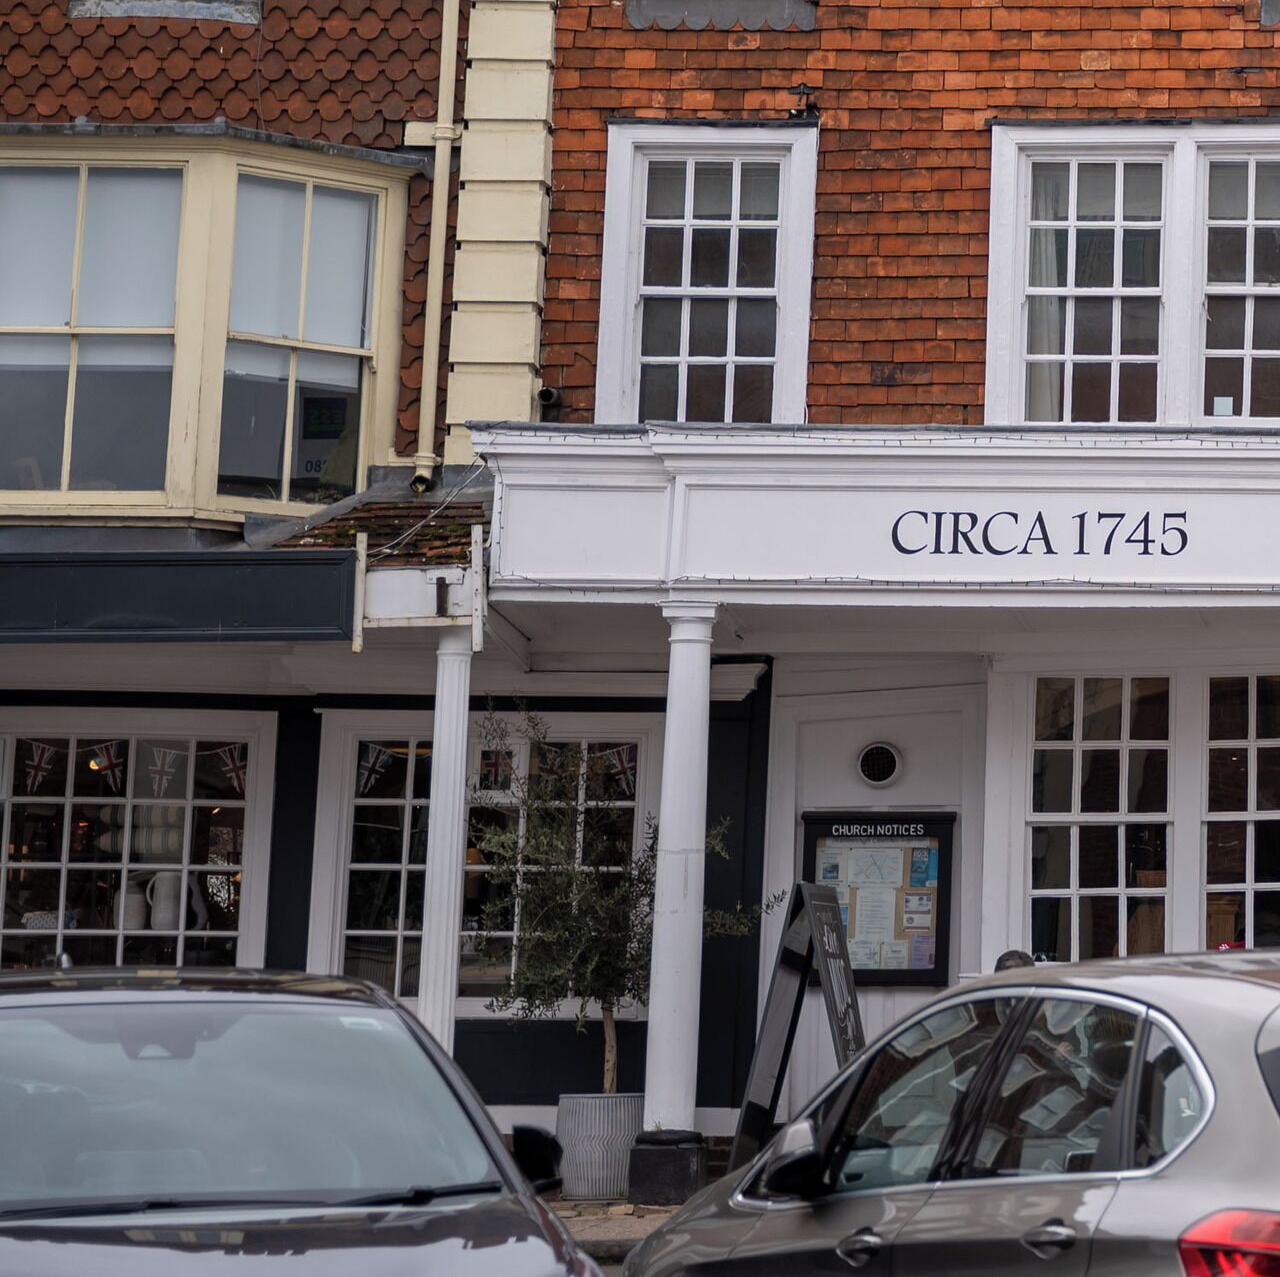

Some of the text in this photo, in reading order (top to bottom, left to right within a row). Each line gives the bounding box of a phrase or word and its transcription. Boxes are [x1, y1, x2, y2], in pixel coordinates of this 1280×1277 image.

[891, 510, 1189, 556] CIRCA 1745
[832, 824, 925, 836] CHURCH NOTICES
